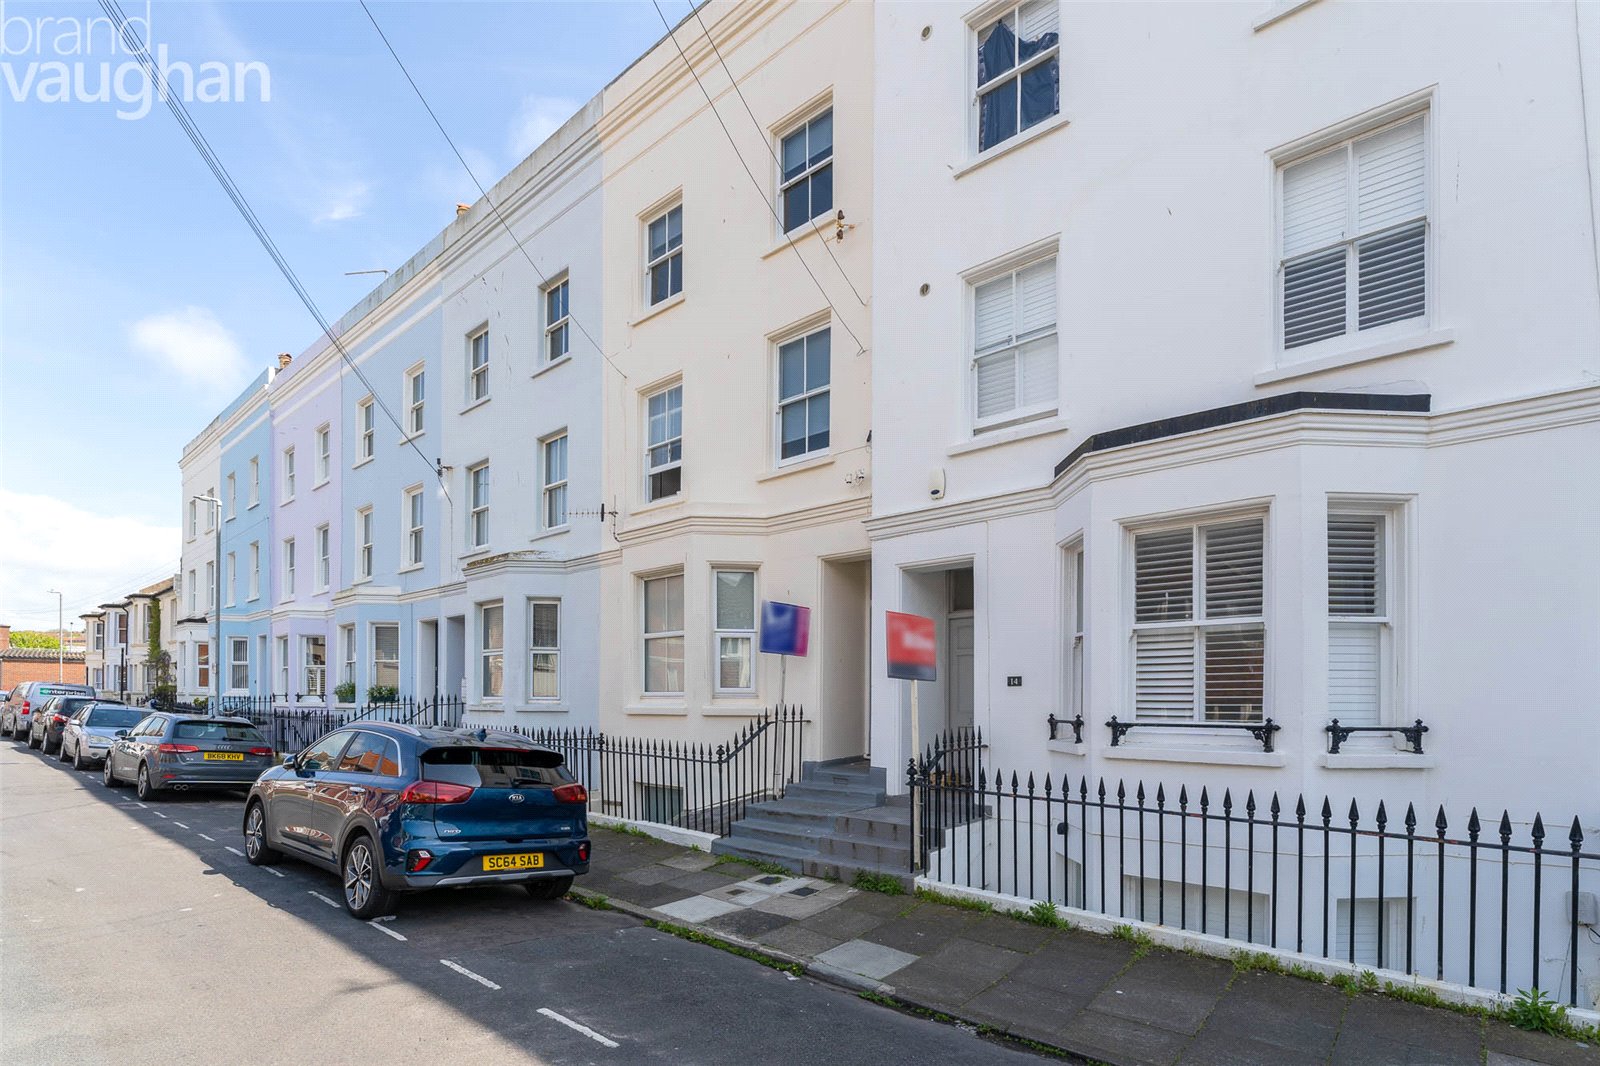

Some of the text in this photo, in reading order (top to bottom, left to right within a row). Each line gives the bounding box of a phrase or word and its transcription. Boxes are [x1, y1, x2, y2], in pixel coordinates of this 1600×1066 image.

[41, 688, 86, 696] enterprise
[488, 855, 539, 868] SC64 SAB
